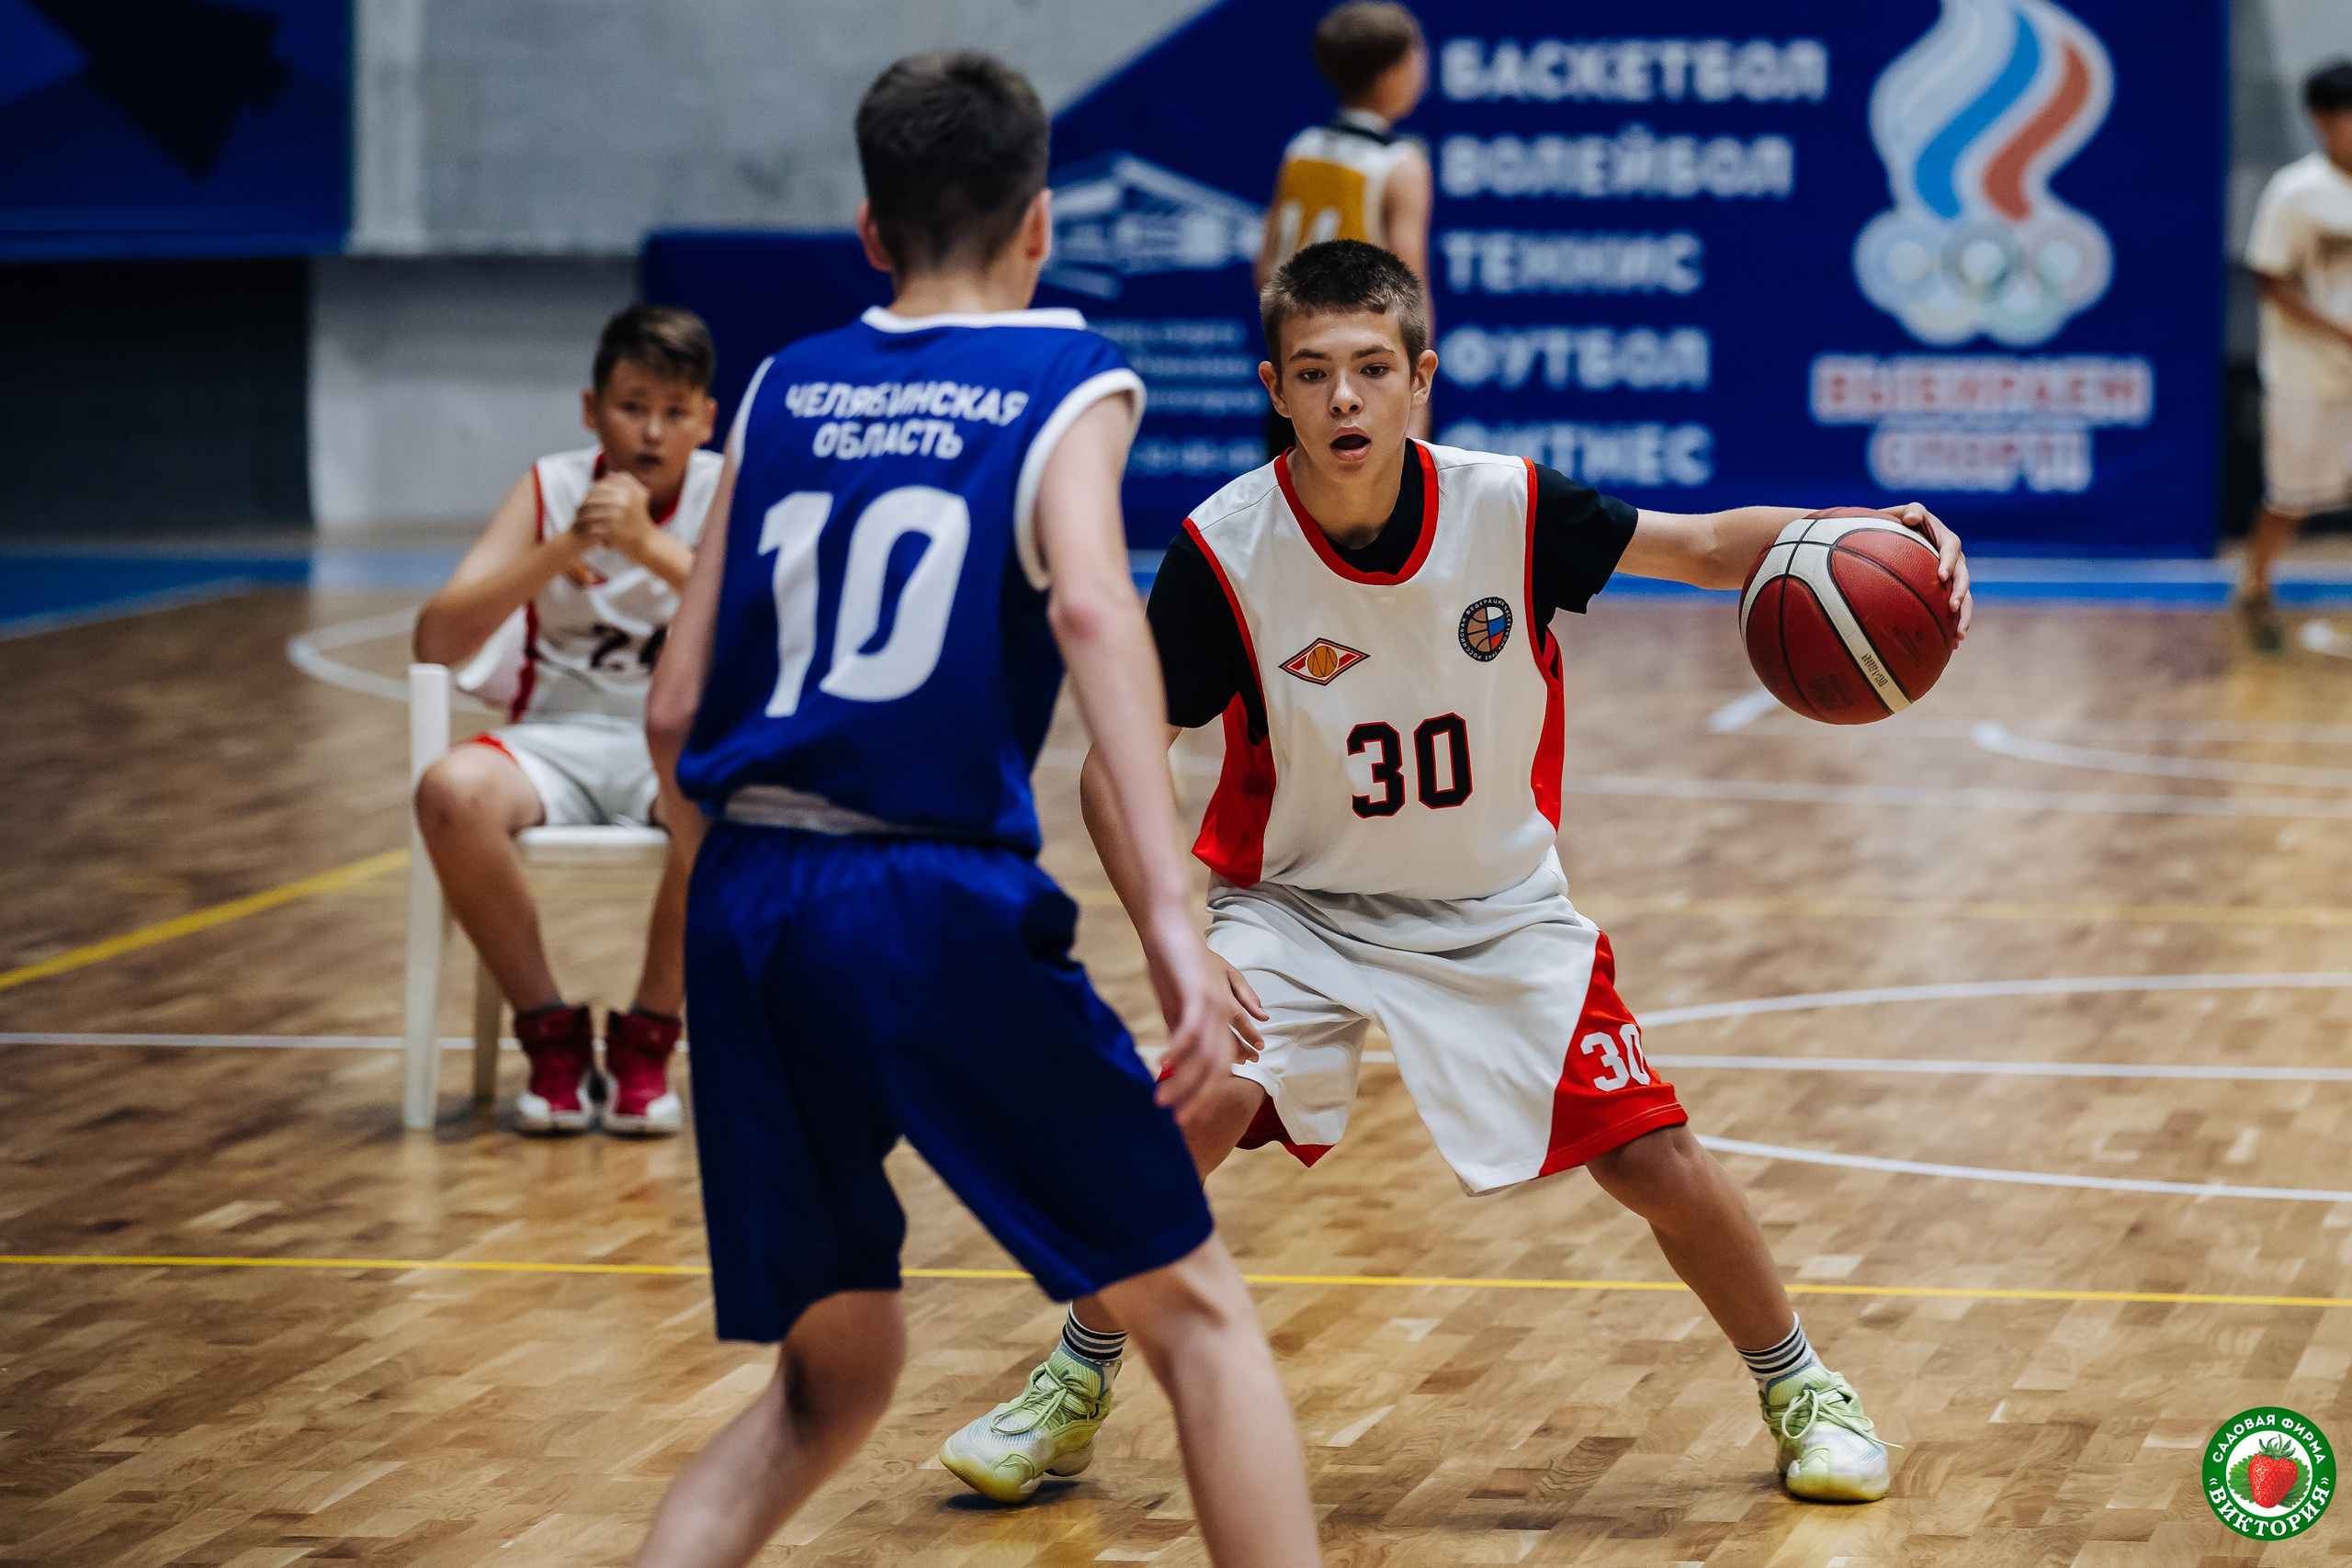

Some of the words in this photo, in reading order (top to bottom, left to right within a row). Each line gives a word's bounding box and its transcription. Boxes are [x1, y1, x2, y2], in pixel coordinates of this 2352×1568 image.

[1442, 38, 1829, 102] БАСКЕТБОЛ
[1442, 123, 1794, 198] ВОЛЕЙБОЛ
[1441, 231, 1704, 295] ТЕННИС
[1439, 324, 1712, 390] ФУТБОЛ
[786, 381, 1030, 426] ЧЕЛЯБИНСКАЯ
[813, 419, 965, 460] ОБЛАСТЬ
[757, 484, 972, 718] 10
[1459, 617, 1483, 660] РОССИЙСКАЯ
[1346, 711, 1474, 819] 30
[1580, 1023, 1651, 1092] 30
